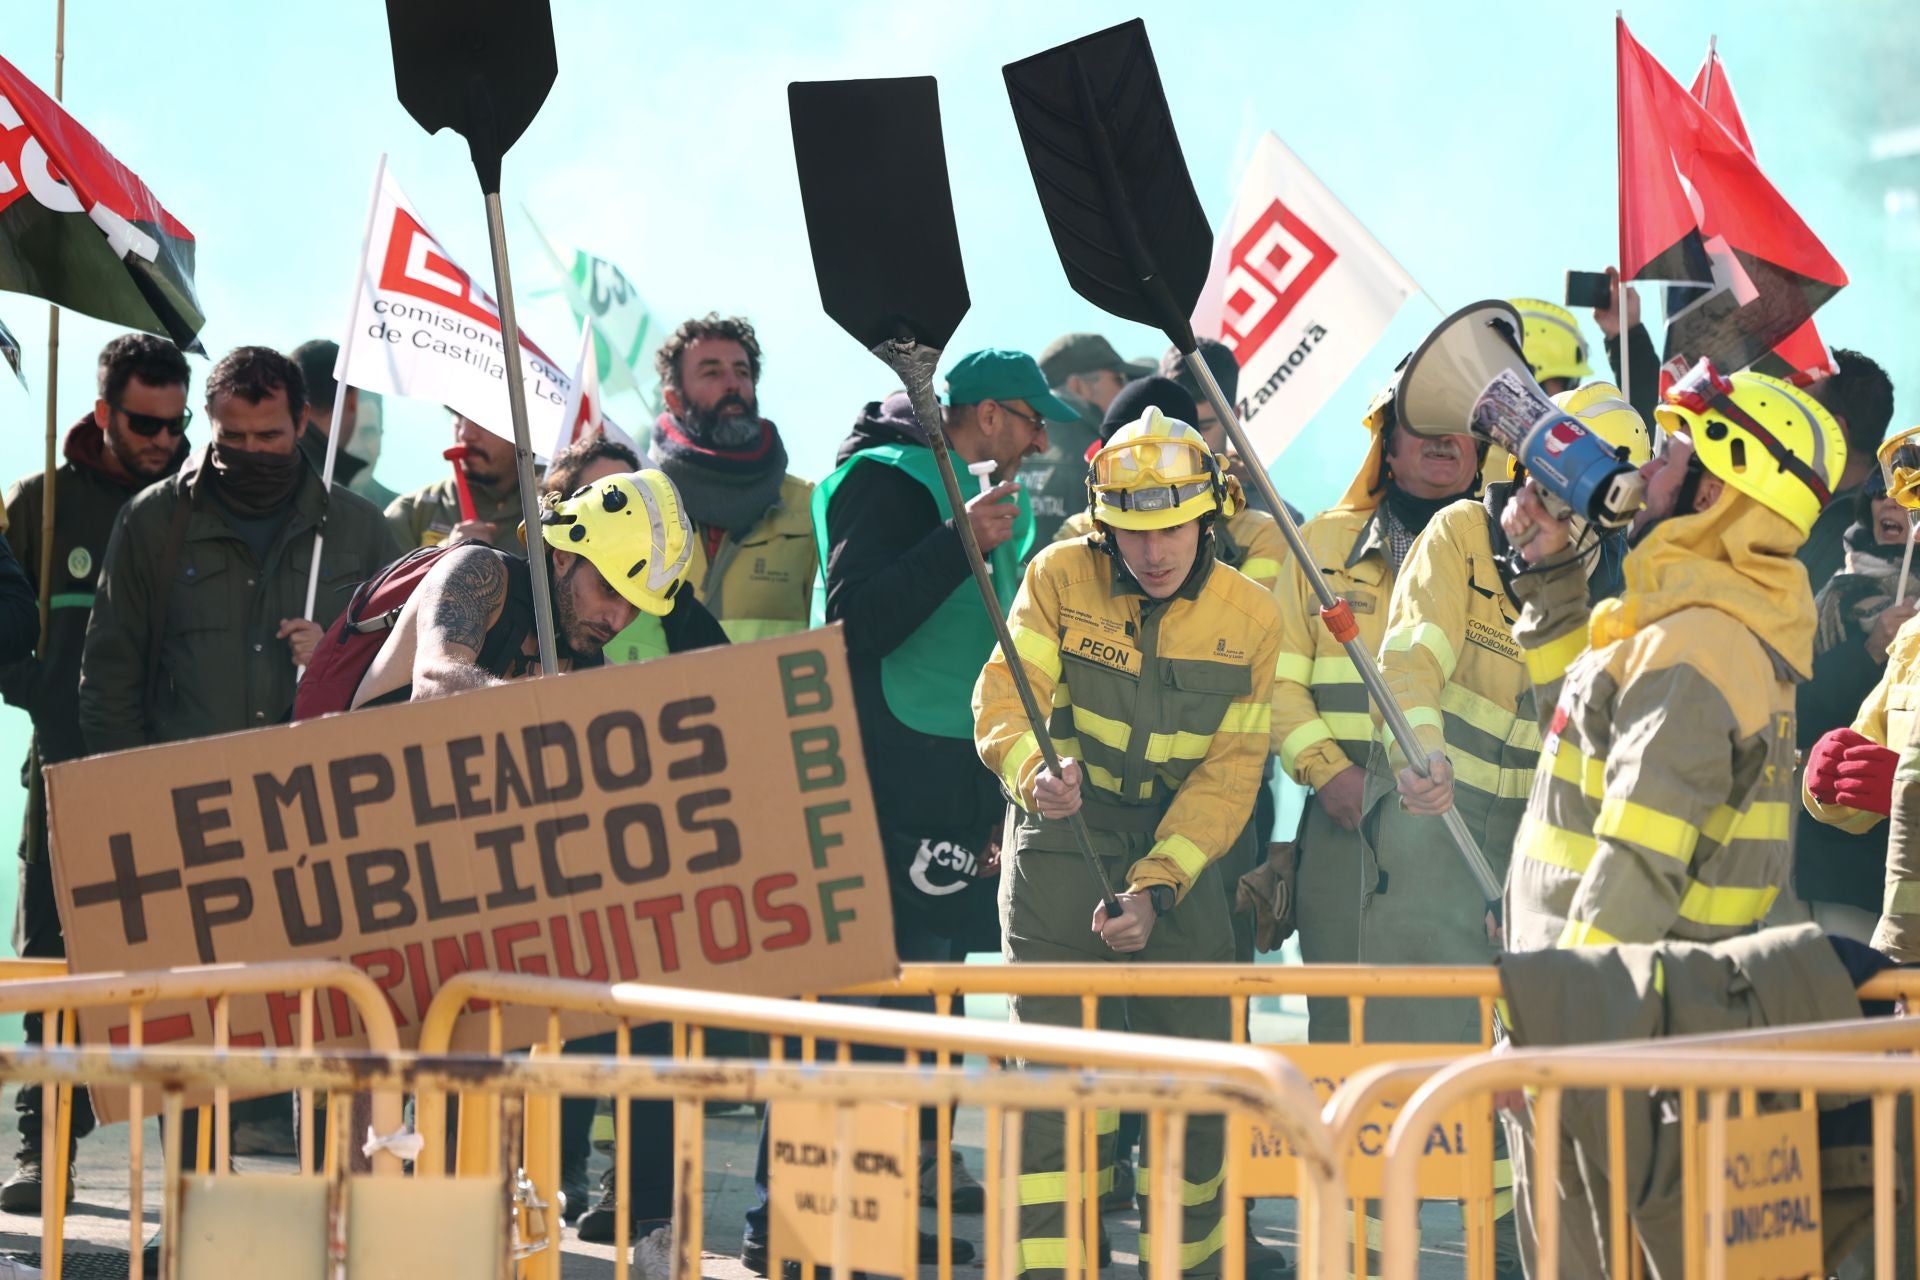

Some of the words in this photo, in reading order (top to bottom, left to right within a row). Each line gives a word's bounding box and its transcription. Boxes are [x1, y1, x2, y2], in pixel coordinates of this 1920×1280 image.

[368, 322, 402, 344] de
[412, 329, 505, 380] Castilla
[534, 381, 568, 405] Le
[373, 300, 505, 354] comisione
[529, 360, 571, 391] obr
[1238, 322, 1328, 422] Zamora
[1079, 637, 1130, 666] PEON
[1465, 629, 1519, 660] AUTOBOMBA
[171, 696, 728, 869] EMPLEADOS
[187, 788, 742, 964] PÚBLICOS
